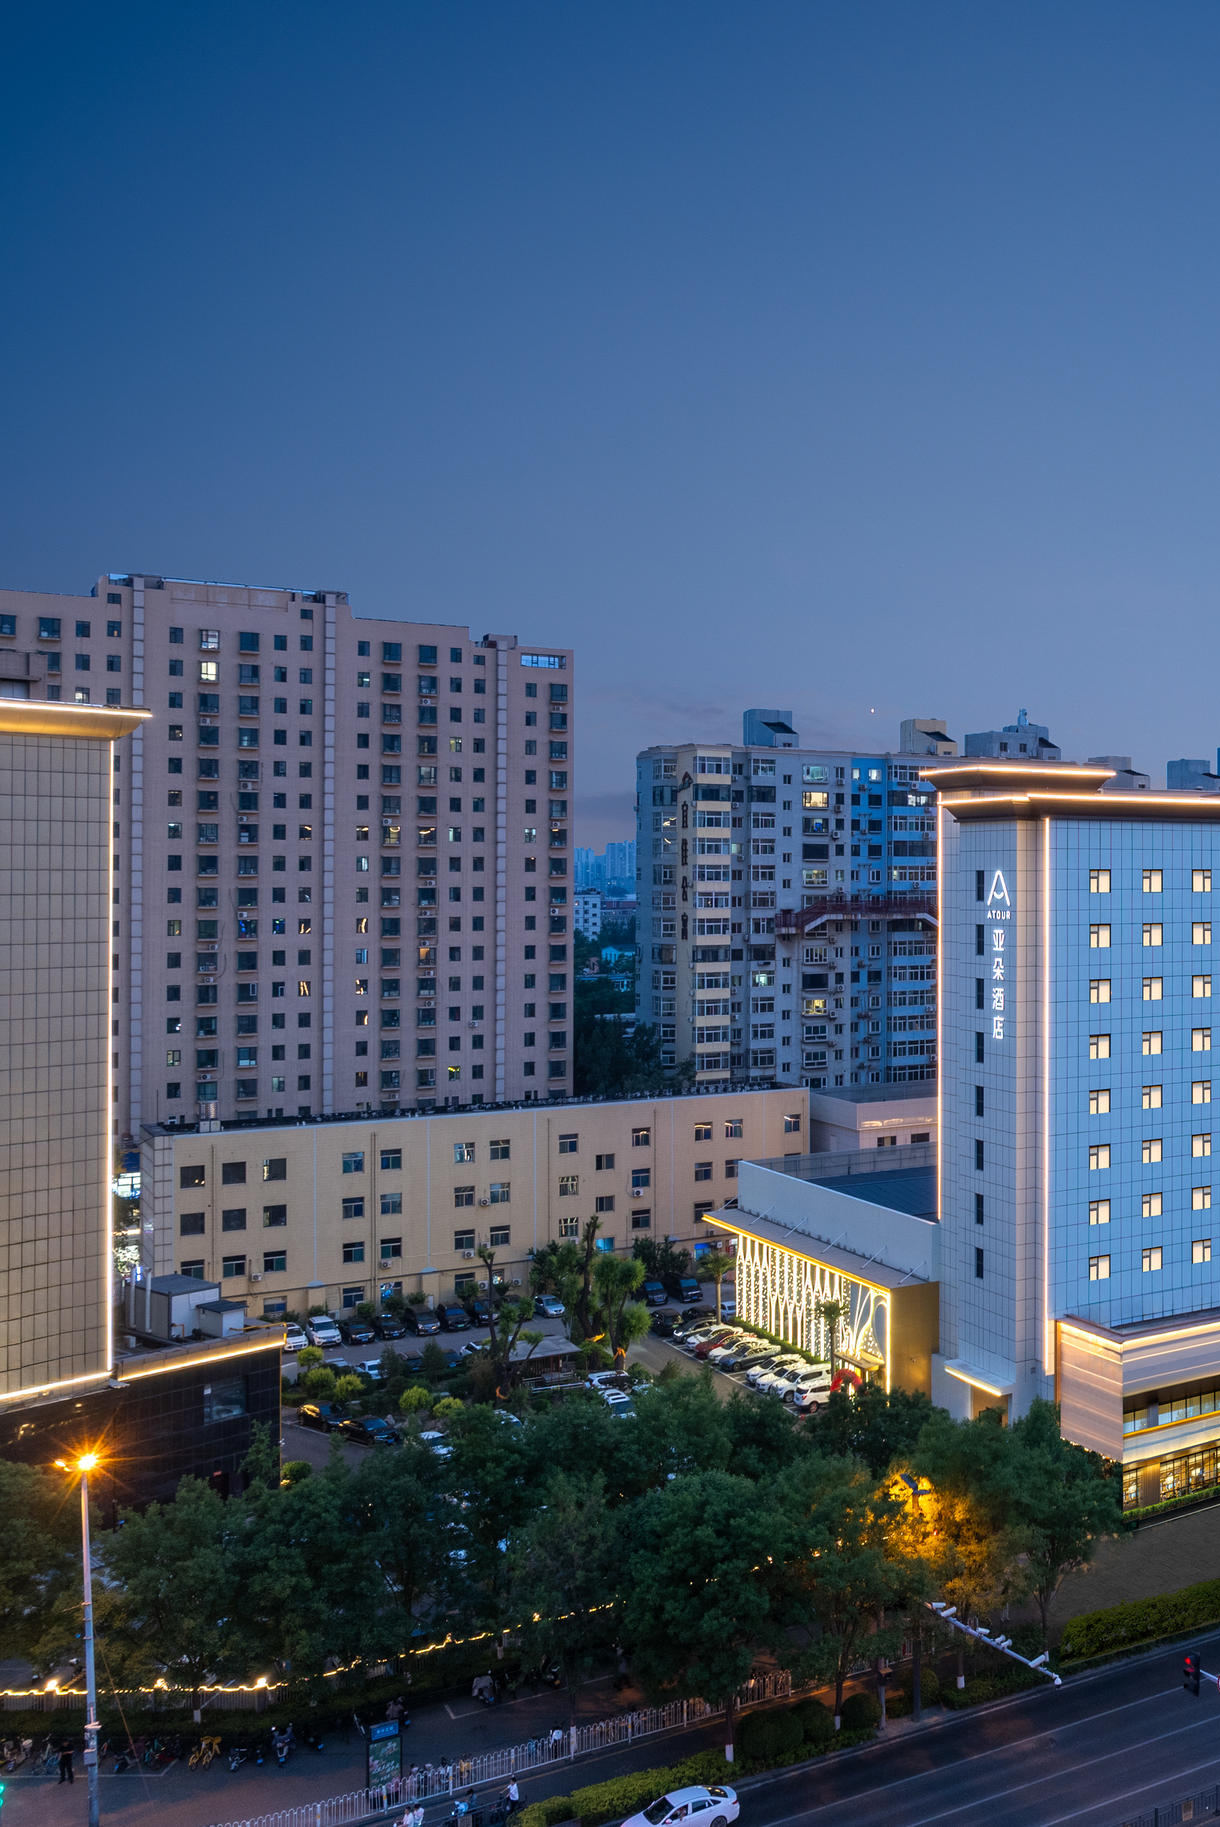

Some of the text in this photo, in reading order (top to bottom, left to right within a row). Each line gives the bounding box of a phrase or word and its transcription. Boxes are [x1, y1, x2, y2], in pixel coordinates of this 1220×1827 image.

[987, 910, 1011, 920] ATOUR
[992, 929, 1005, 1040] 亚朵酒店
